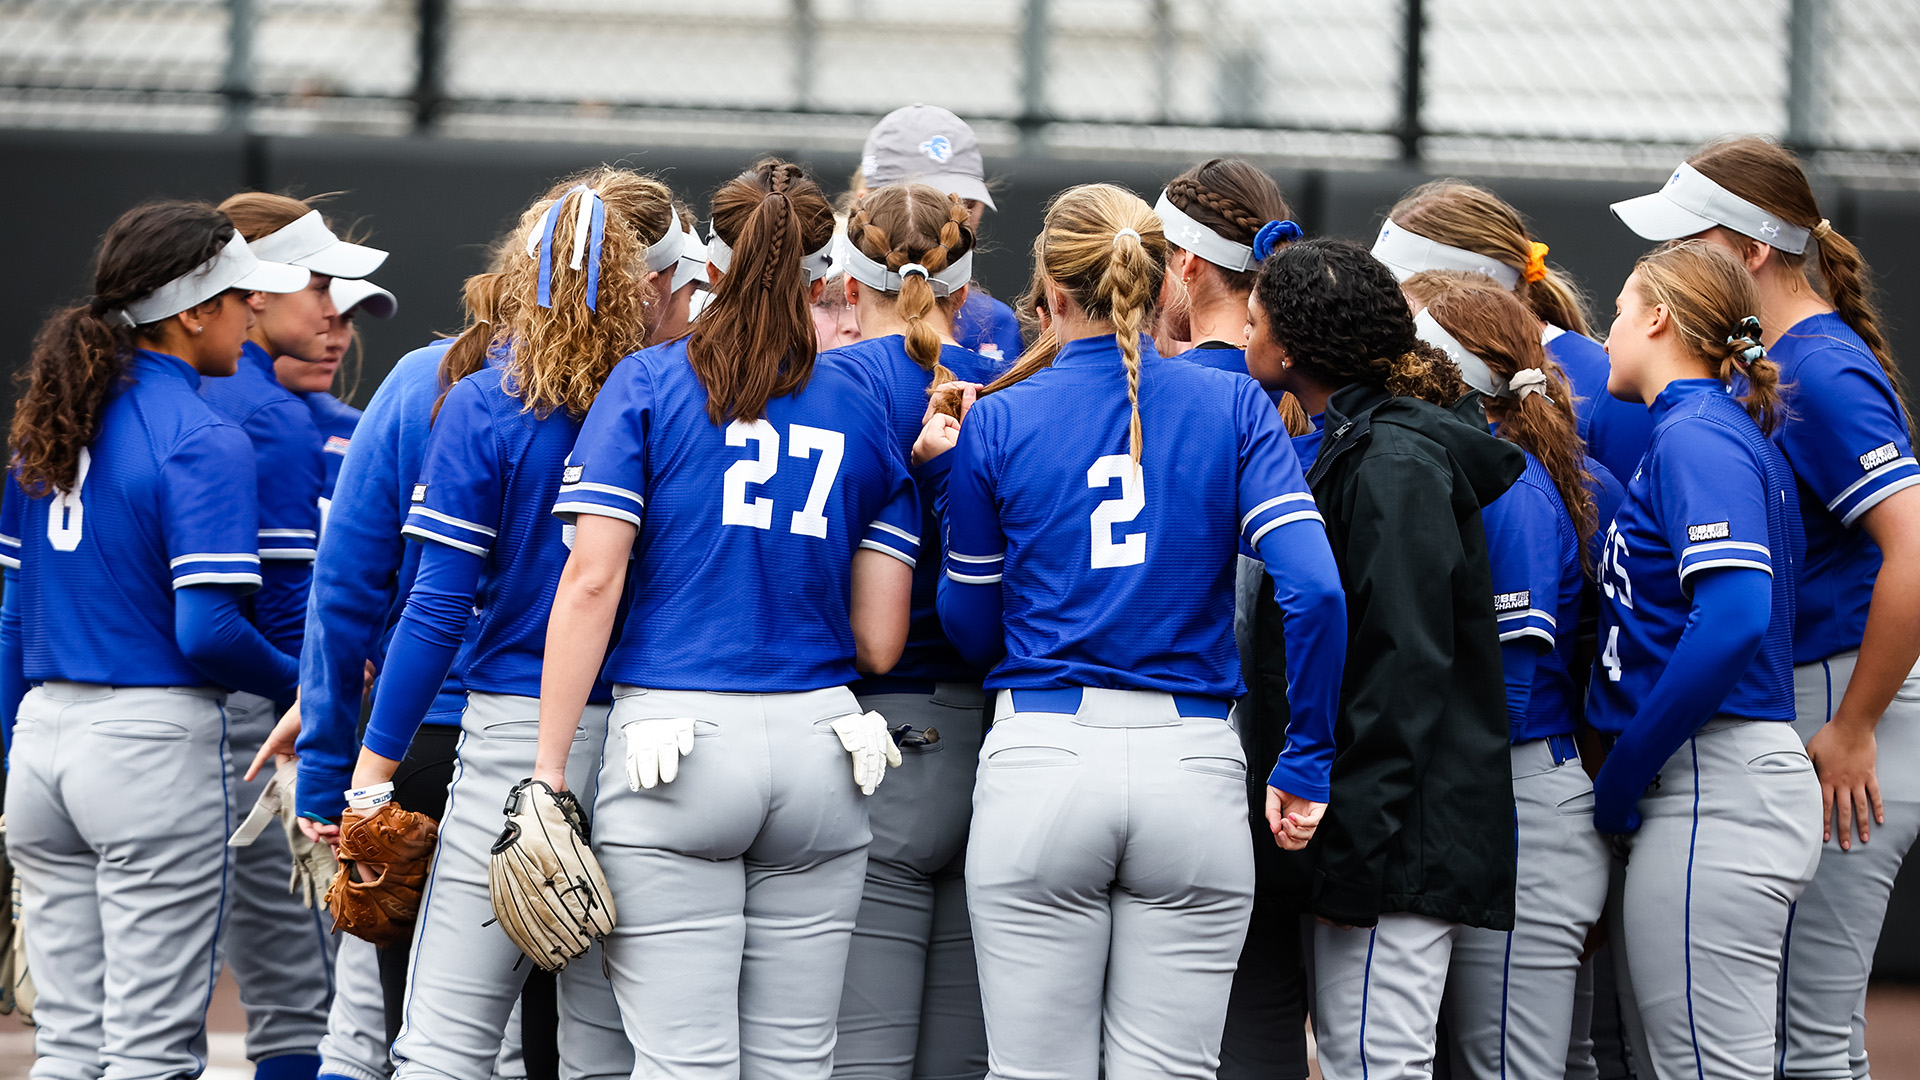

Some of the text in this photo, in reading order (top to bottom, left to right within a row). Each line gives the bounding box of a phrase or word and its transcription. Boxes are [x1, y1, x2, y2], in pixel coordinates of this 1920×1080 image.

[1862, 449, 1899, 470] CHANGE
[1867, 447, 1885, 460] BE
[722, 418, 845, 540] 27
[1086, 453, 1147, 570] 2
[1689, 530, 1729, 541] CHANGE
[1697, 523, 1715, 534] BE
[1500, 592, 1517, 603] BE
[1602, 625, 1622, 682] 4
